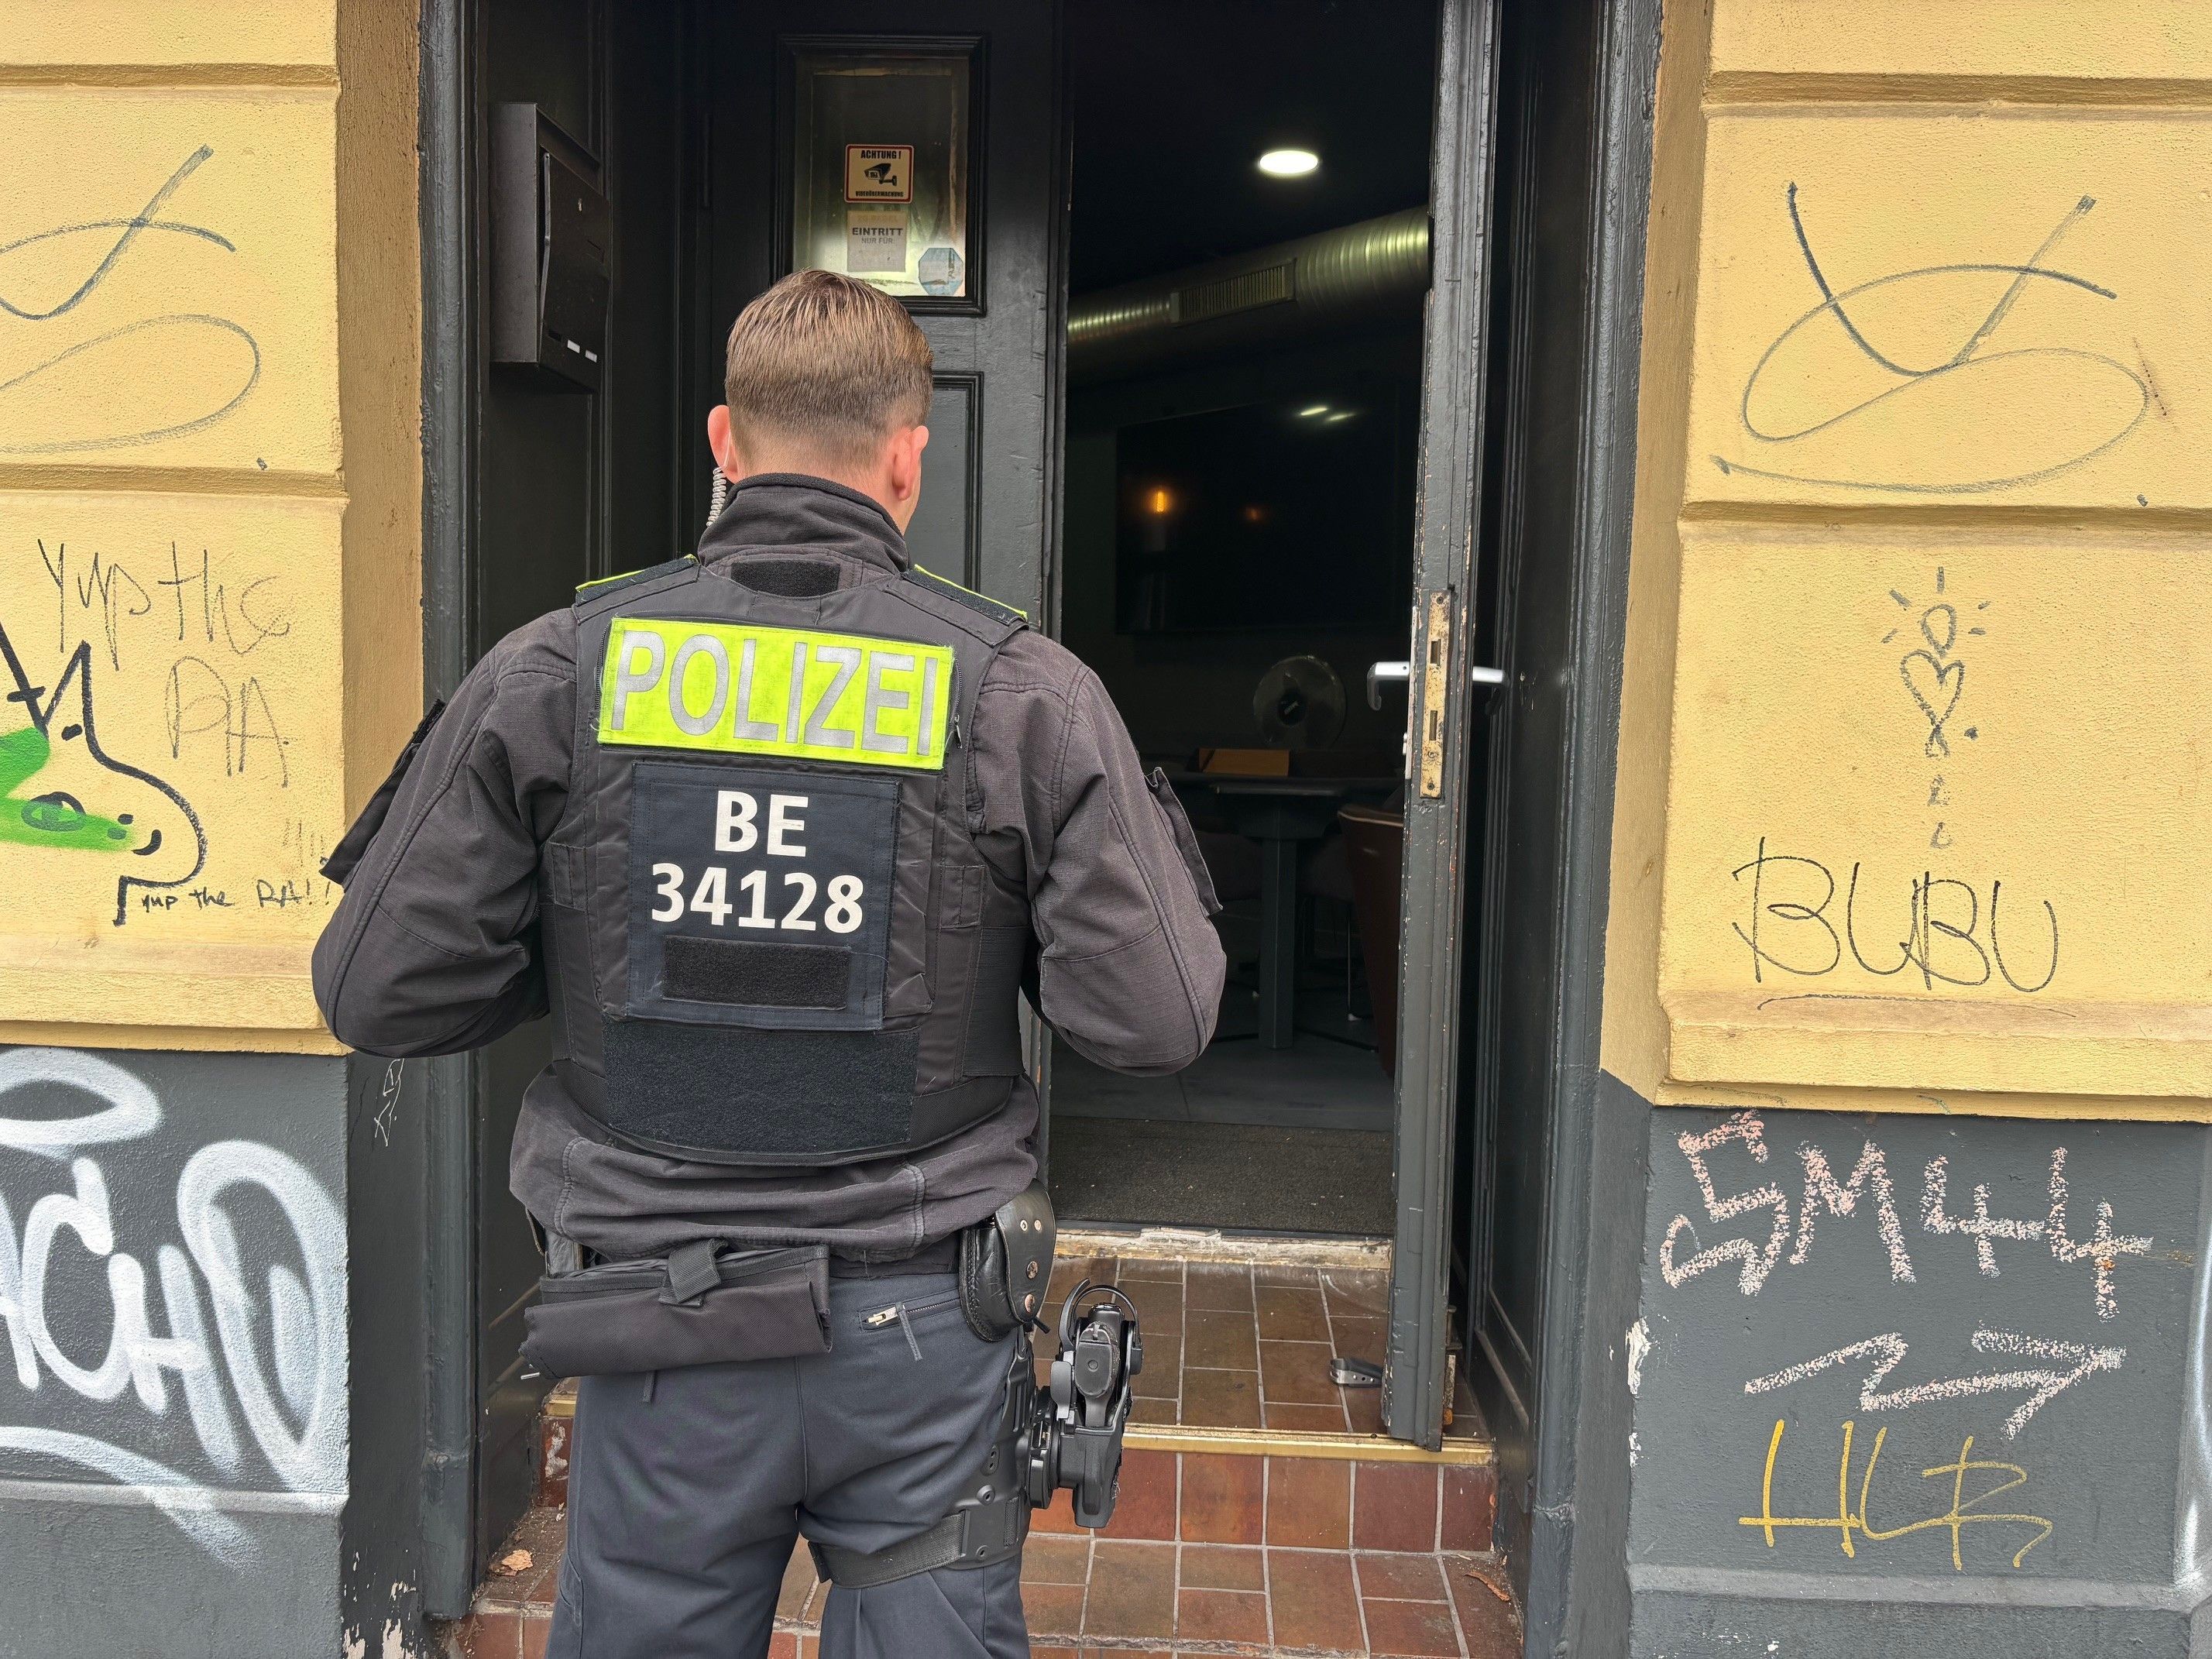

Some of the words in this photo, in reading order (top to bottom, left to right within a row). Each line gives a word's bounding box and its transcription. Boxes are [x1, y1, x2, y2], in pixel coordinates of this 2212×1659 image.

[860, 149, 897, 160] ACHTUNG
[852, 227, 903, 236] EINTRITT
[610, 630, 939, 757] POLIZEI
[714, 790, 809, 857] BE
[651, 863, 865, 934] 34128
[1732, 836, 2059, 993] BUBU
